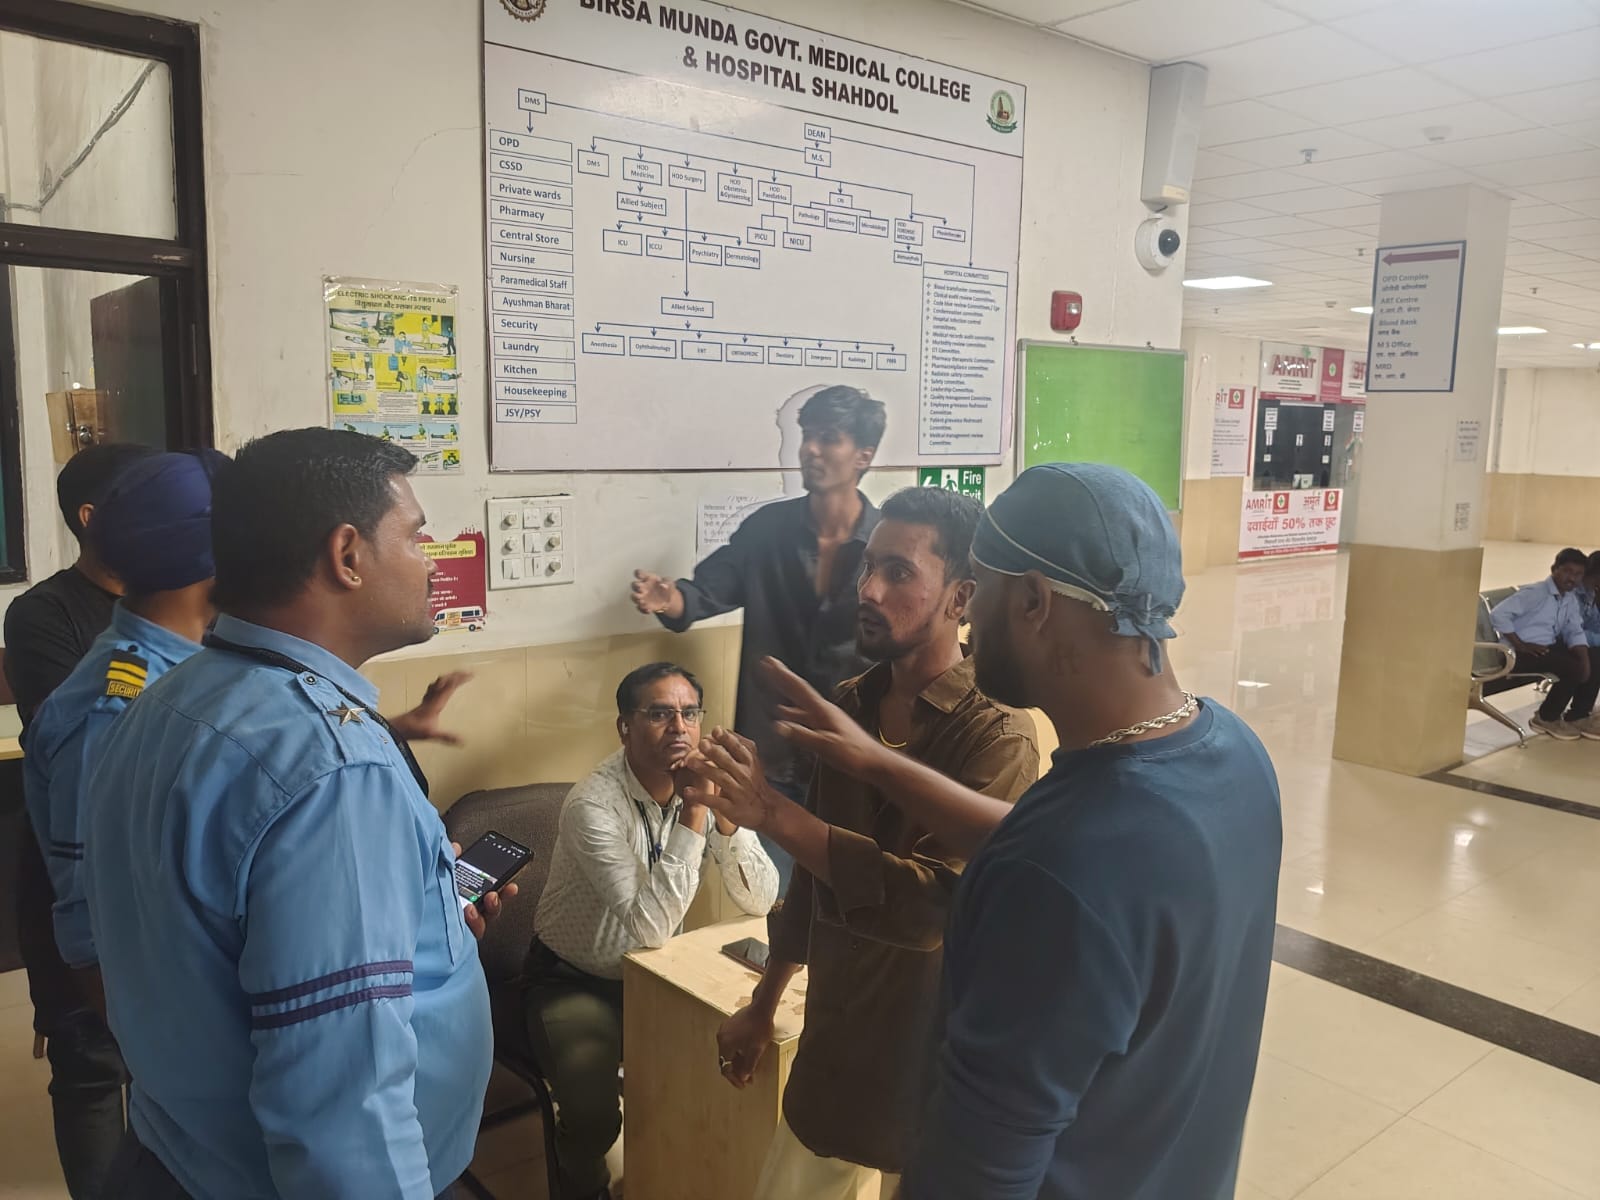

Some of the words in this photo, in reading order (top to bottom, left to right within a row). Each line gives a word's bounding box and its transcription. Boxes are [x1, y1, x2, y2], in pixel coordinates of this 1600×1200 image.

[659, 6, 738, 46] MUNDA
[744, 28, 802, 62] GOVT.
[808, 44, 890, 84] MEDICAL
[896, 68, 972, 103] COLLEGE
[683, 46, 698, 69] &
[706, 51, 806, 94] HOSPITAL
[812, 76, 900, 115] SHAHDOL
[524, 96, 540, 106] DMS
[808, 128, 826, 138] DEAN
[498, 136, 520, 148] OPD
[811, 153, 824, 162] M.S.
[498, 160, 523, 172] CSSD
[586, 160, 600, 168] DMS
[630, 168, 655, 180] Medicine
[672, 172, 684, 181] HOD
[684, 174, 703, 185] Surgery
[498, 182, 532, 198] Private
[534, 188, 562, 201] wards
[620, 198, 638, 208] Allied
[639, 200, 664, 212] Subject
[498, 205, 545, 222] Pharmacy
[500, 229, 532, 243] Central
[535, 234, 560, 246] Store
[754, 232, 768, 241] PICU
[790, 236, 804, 247] NICU
[649, 242, 663, 252] ICCU
[691, 248, 719, 260] Psychiatry
[500, 274, 548, 288] Paramedical
[550, 279, 568, 289] Staff
[1382, 274, 1398, 282] OPD
[337, 290, 369, 299] ELECTRIC
[502, 296, 544, 313] Ayushman
[544, 300, 570, 312] Bharat
[671, 304, 684, 312] Allied
[686, 304, 705, 314] Subject
[500, 318, 538, 332] Security
[502, 341, 540, 354] Laundry
[503, 364, 538, 375] Kitchen
[1272, 354, 1316, 379] AMRIT
[504, 386, 568, 398] Housekeeping
[1216, 392, 1228, 404] RIT
[504, 407, 541, 420] JSY/PSY
[963, 470, 982, 486] Fire
[1246, 498, 1272, 510] AMRIT
[1282, 517, 1306, 530] 50%
[1309, 518, 1323, 528] तक
[110, 683, 141, 697] SECURIT
